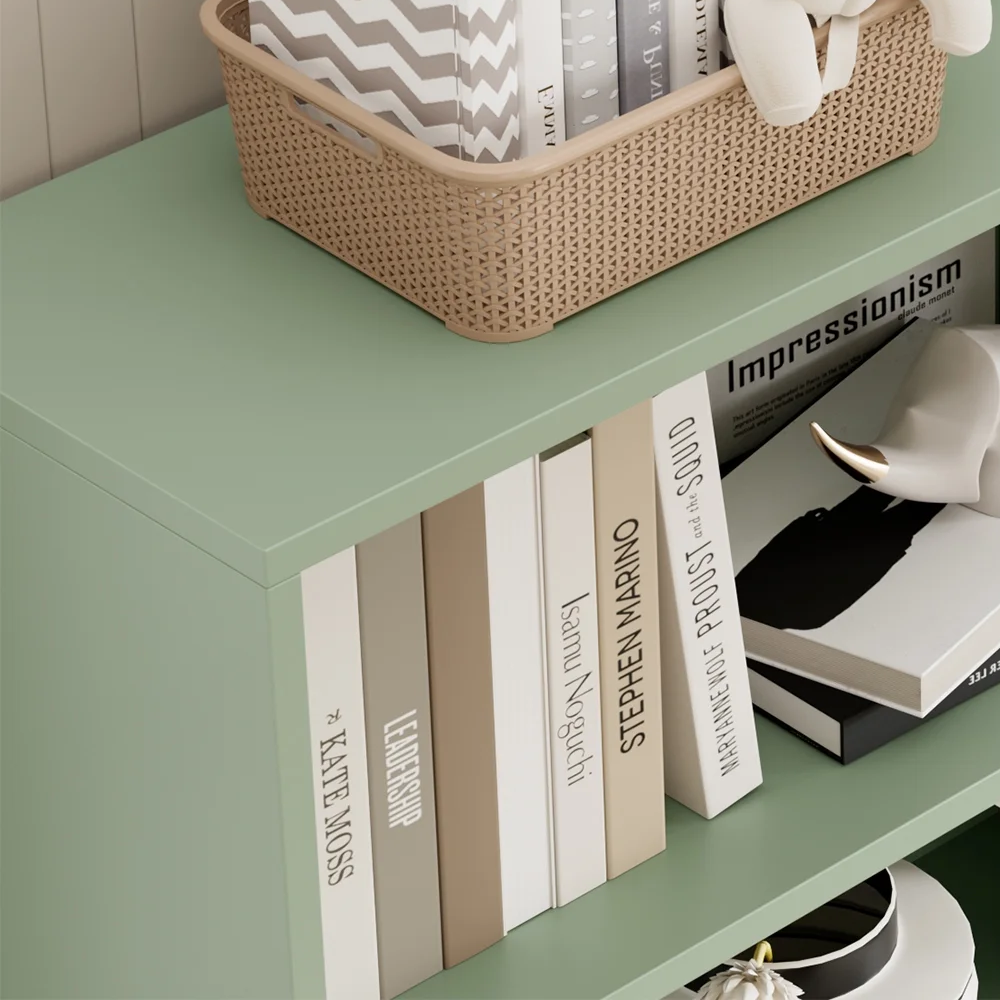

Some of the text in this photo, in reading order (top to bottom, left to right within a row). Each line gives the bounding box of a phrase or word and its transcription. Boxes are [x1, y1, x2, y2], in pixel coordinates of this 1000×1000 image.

[728, 258, 961, 394] Impressionism
[897, 300, 926, 321] claude
[928, 285, 955, 305] monet
[668, 416, 724, 639] PROUST and the SQUID
[556, 591, 595, 788] Isamu Noguchi
[612, 517, 646, 755] STEPHEN MARINO
[702, 641, 740, 778] MARYANNE WOLF
[318, 728, 355, 887] KATE MOSS
[383, 708, 422, 829] LEADERSHIP
